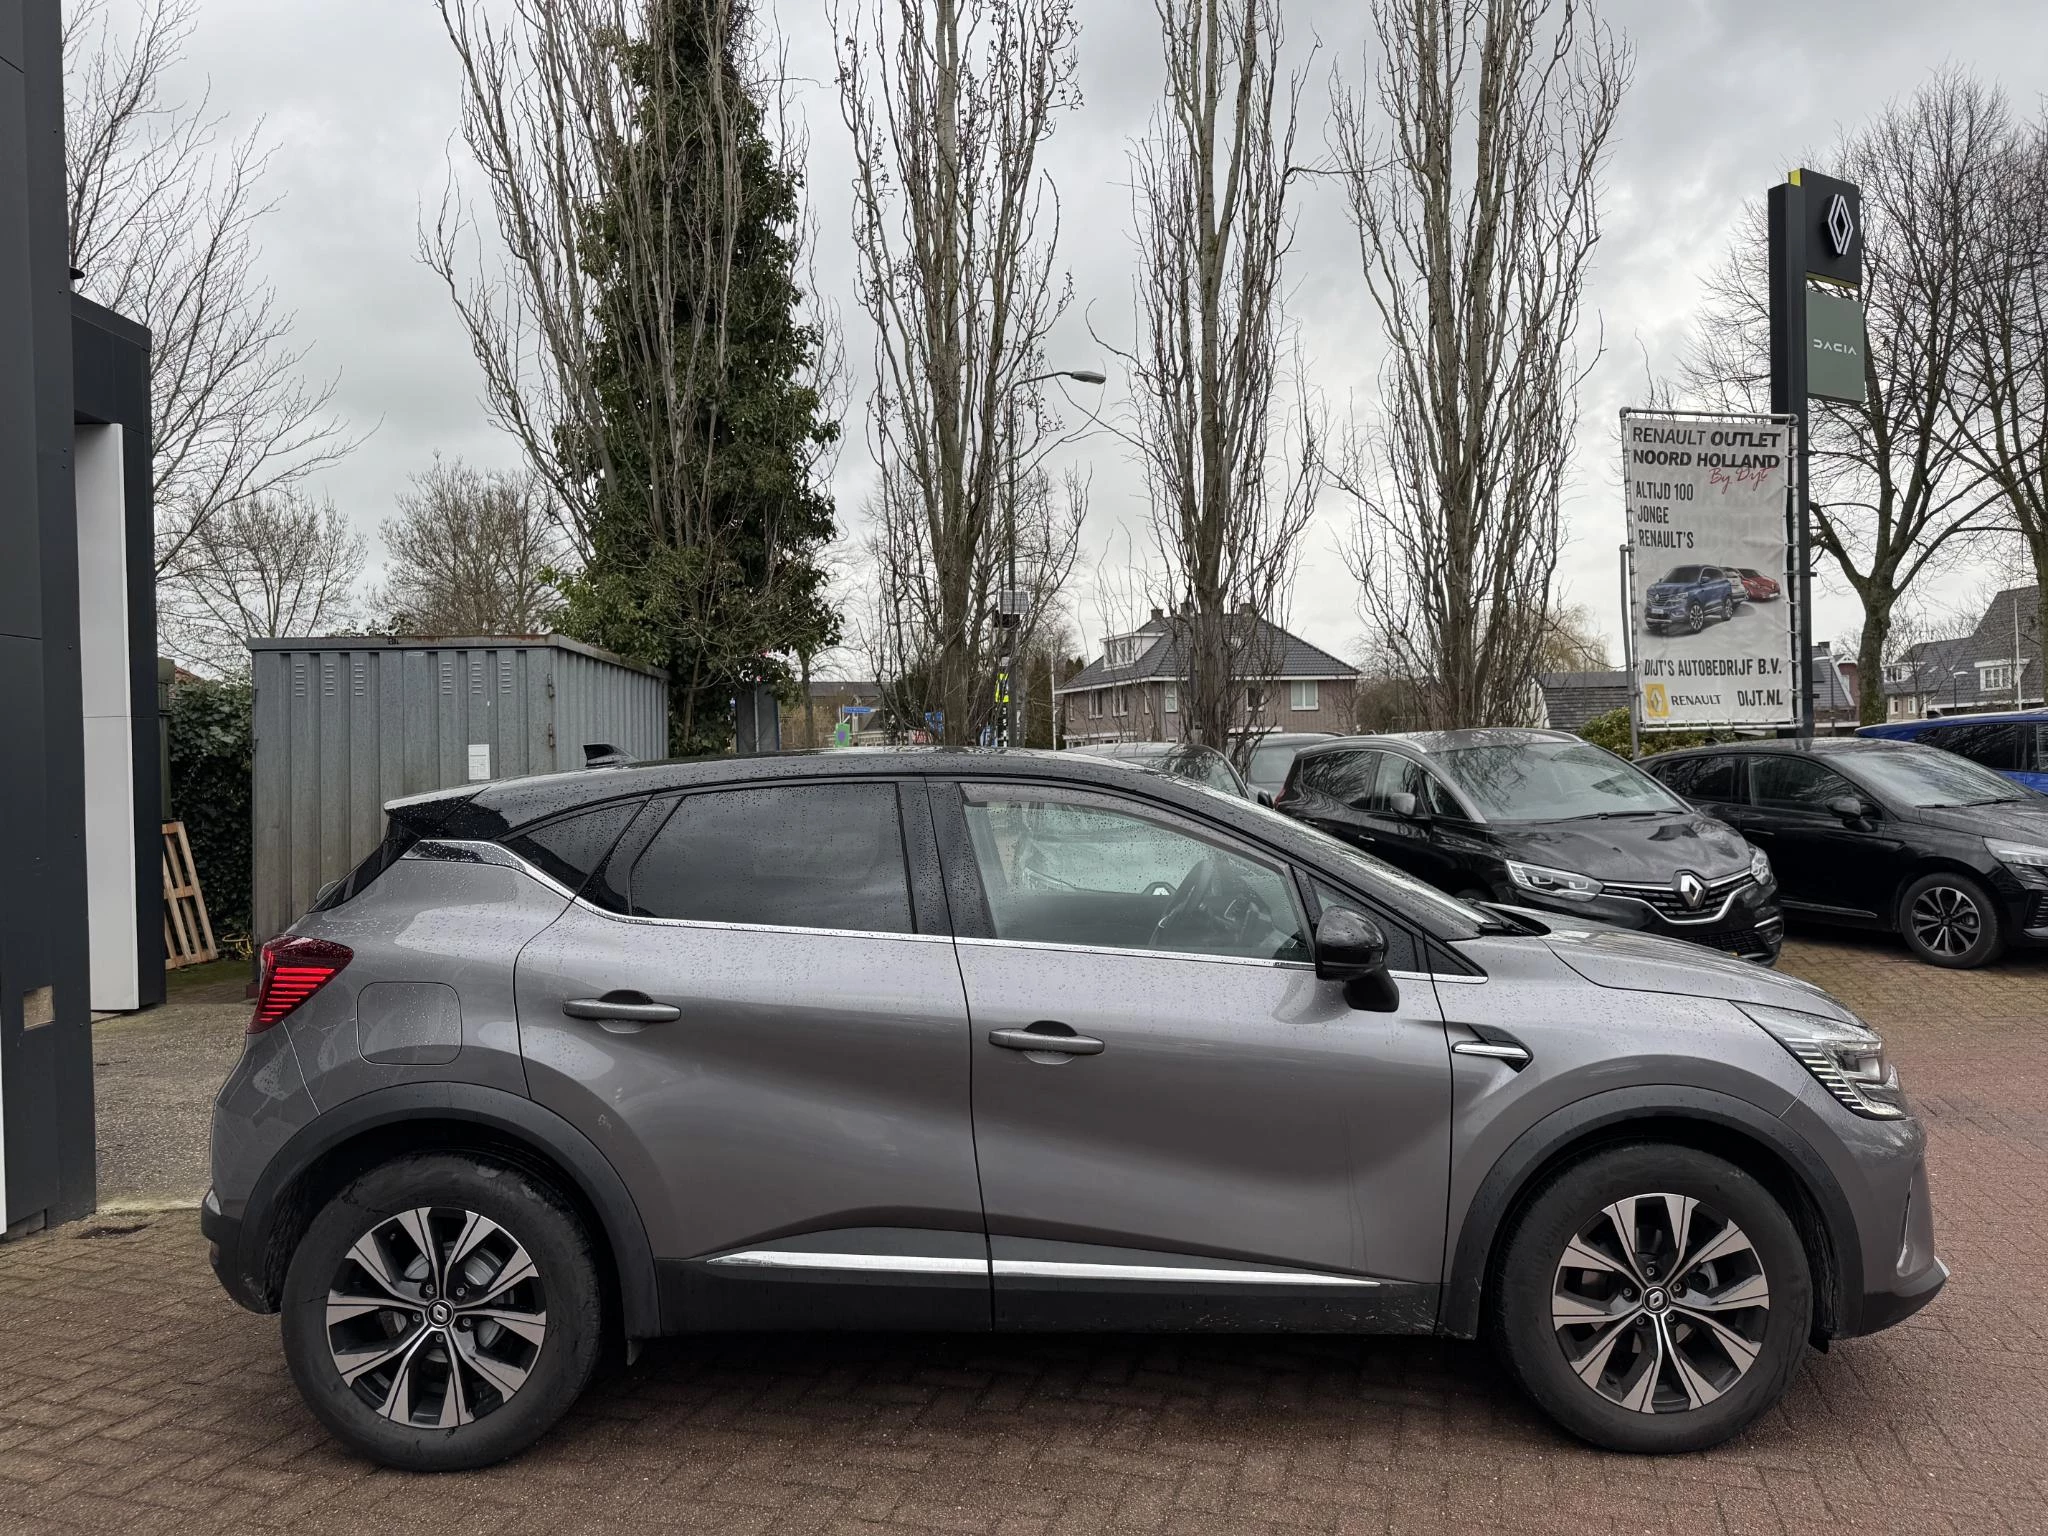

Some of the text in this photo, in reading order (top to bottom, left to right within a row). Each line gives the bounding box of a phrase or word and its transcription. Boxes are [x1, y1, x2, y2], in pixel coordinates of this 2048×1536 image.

[1813, 338, 1857, 356] DACIA
[1632, 426, 1781, 448] RENAULT OUTLET
[1633, 449, 1781, 469] NOORD HOLLAND
[1636, 480, 1694, 501] ALTIJD 100
[1709, 467, 1730, 495] By
[1637, 505, 1669, 524] JONGE
[1638, 528, 1694, 549] RENAULT'S
[1644, 657, 1783, 677] DIJT'S AUTOBEDRIJF B.V.
[1670, 694, 1722, 706] RENAULT
[1737, 688, 1784, 707] DIJT.NL
